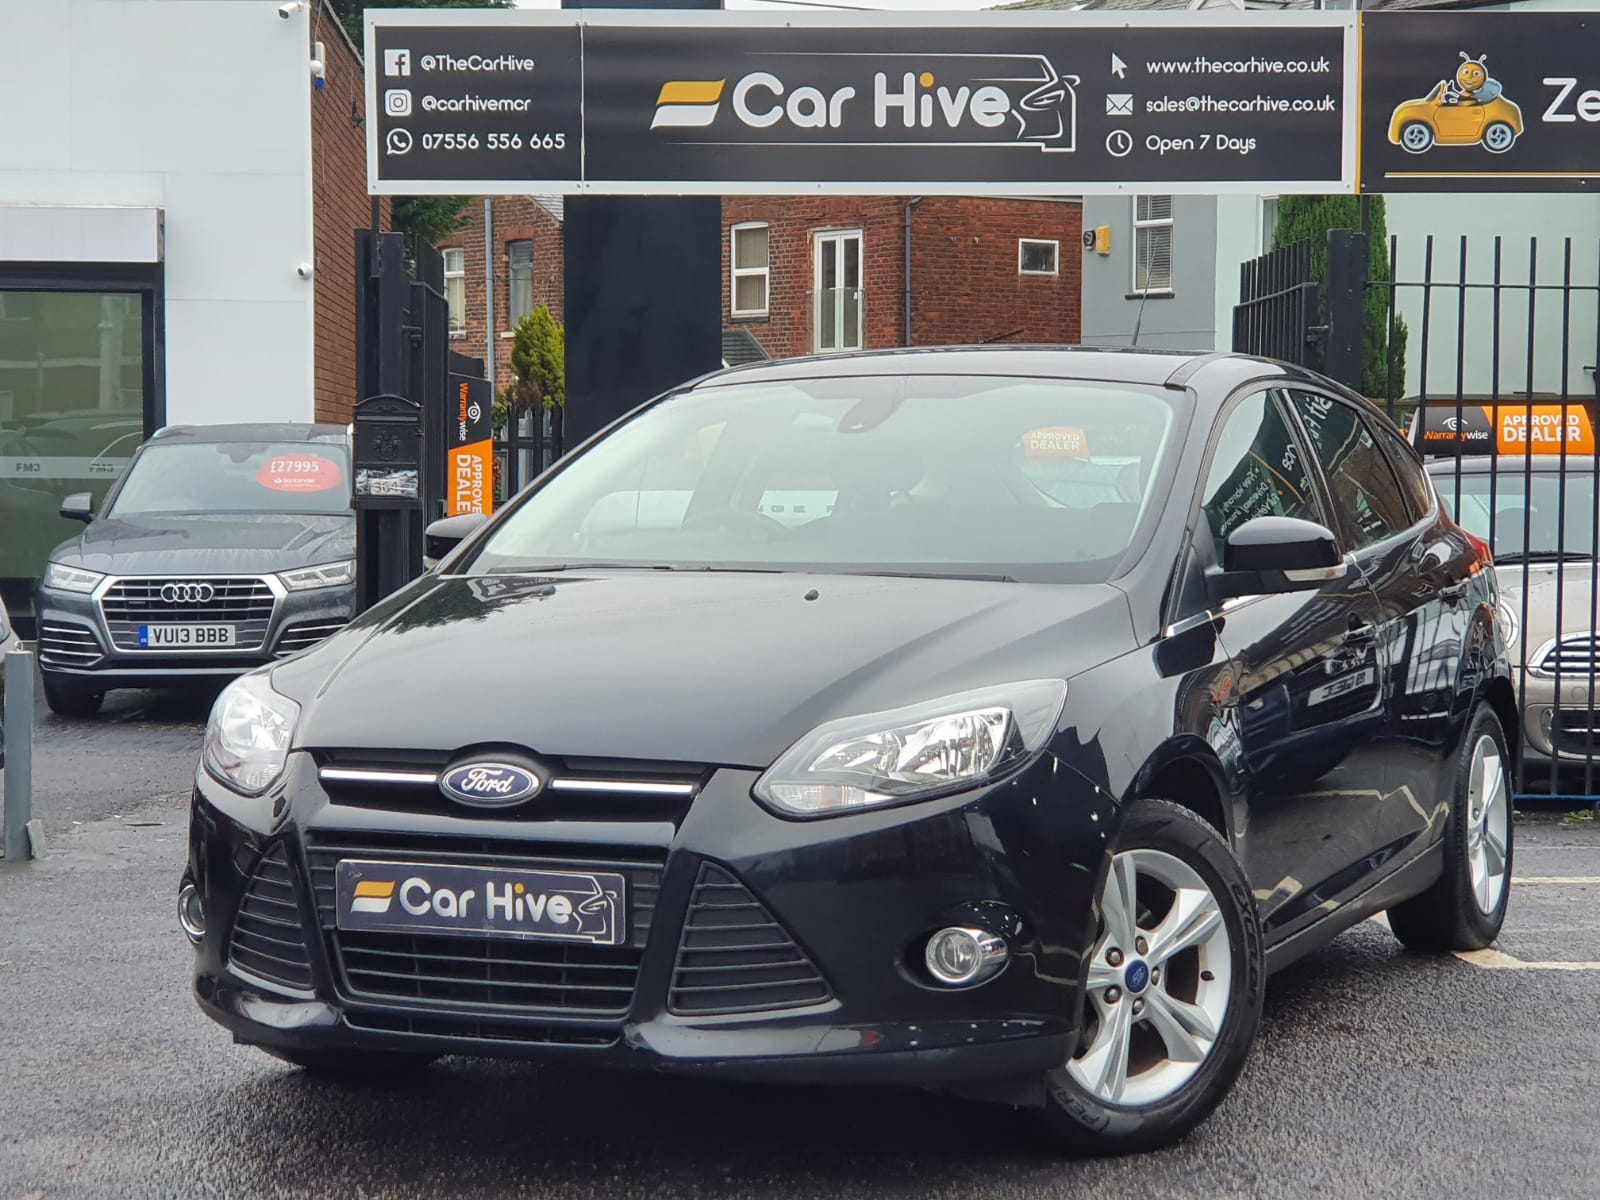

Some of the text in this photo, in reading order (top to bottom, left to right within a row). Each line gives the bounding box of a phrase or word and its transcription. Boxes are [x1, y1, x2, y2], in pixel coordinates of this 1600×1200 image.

[421, 54, 535, 71] @TheCarHive
[1146, 56, 1330, 73] www.thecarhive.co.uk
[421, 95, 532, 111] @carhivemcr
[732, 71, 1011, 128] Car Hive
[1146, 94, 1336, 112] sales@thecarhive.co.uk
[422, 133, 566, 149] 07556 556 665
[1145, 134, 1257, 155] Open 7 Days
[457, 383, 469, 441] Warrantywise
[1503, 415, 1580, 426] APPROVD
[1031, 431, 1080, 441] APPROVED
[1424, 430, 1489, 442] Warranywise
[1030, 440, 1081, 451] DEALER
[16, 463, 40, 472] FM3
[270, 461, 319, 473] £27995
[456, 454, 471, 512] DEALE
[471, 455, 482, 513] APPROVE
[153, 628, 228, 643] VU13 BBB
[461, 768, 515, 792] Ford
[399, 877, 573, 924] Car Hive
